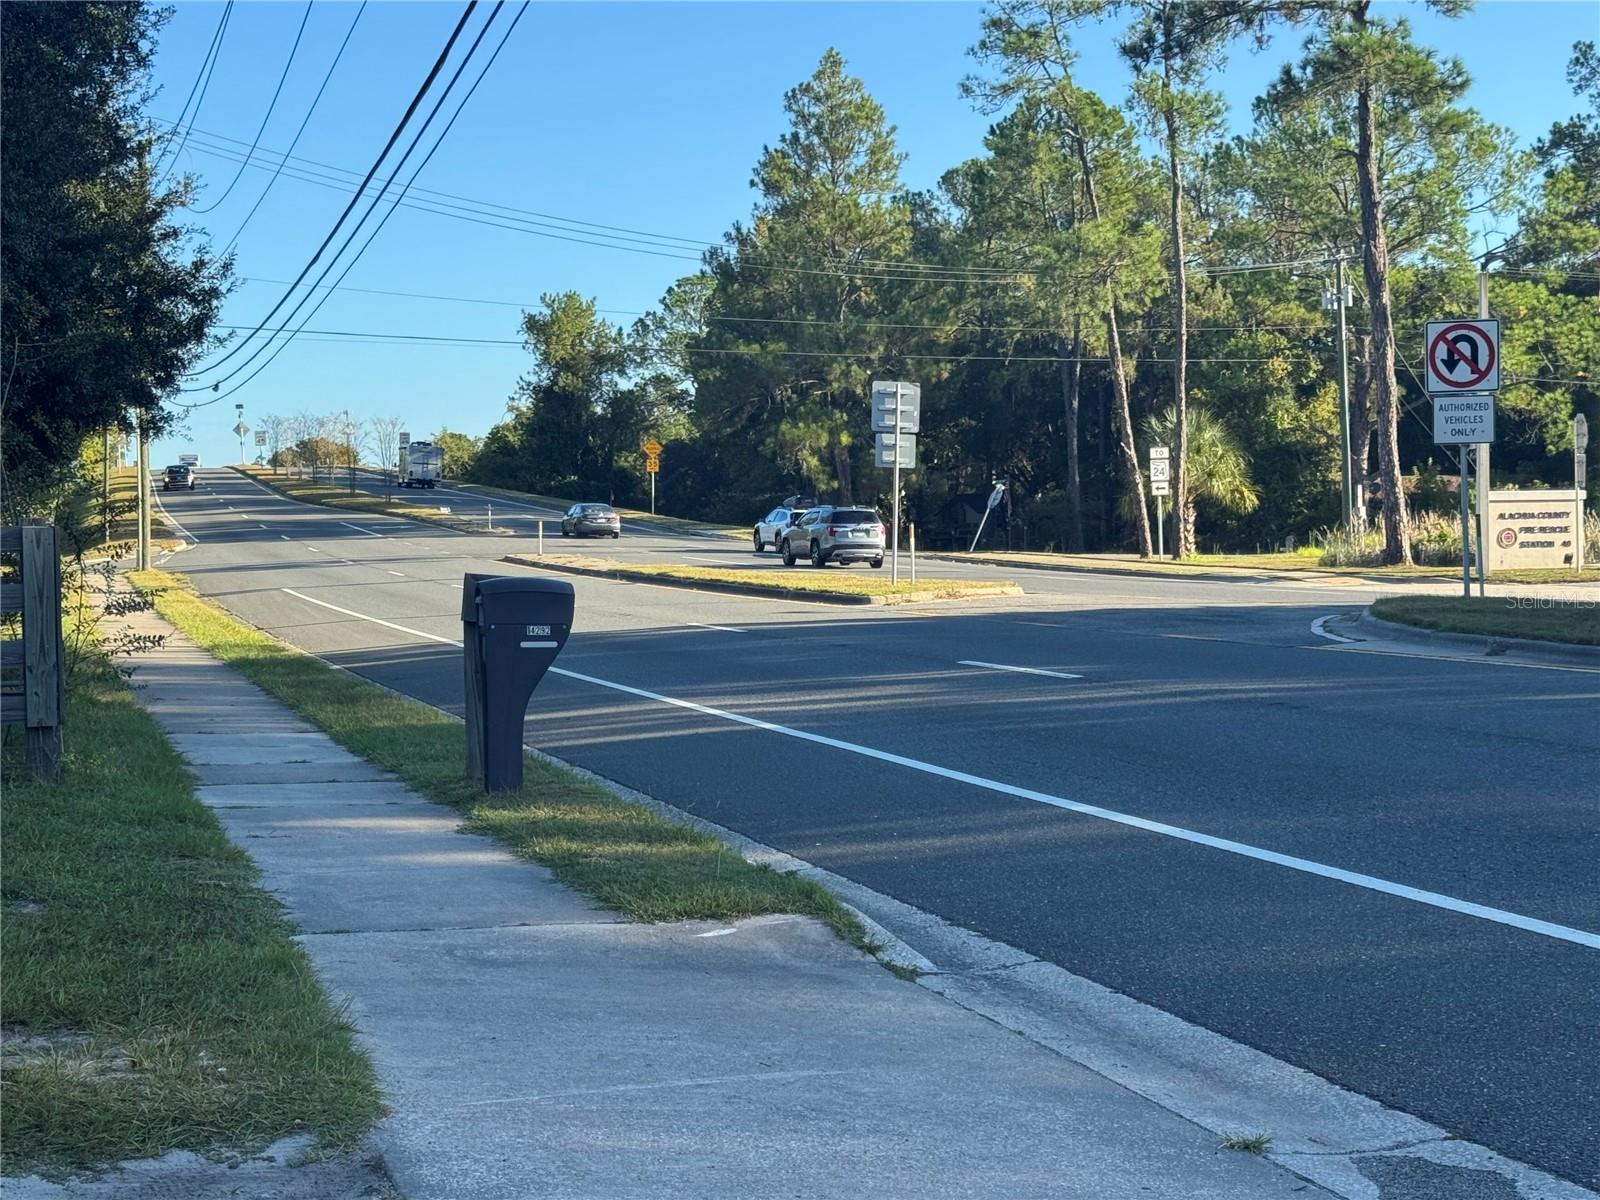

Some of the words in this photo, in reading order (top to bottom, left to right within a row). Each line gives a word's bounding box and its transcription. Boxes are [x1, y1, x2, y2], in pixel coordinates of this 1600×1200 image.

[1438, 402, 1490, 412] AUTHORIZED
[1444, 415, 1484, 425] VEHICLES
[1450, 428, 1477, 437] ONLY
[1153, 467, 1165, 477] 24
[1497, 512, 1536, 520] ALACHUA
[1537, 511, 1571, 519] COUNTY
[1538, 525, 1572, 534] RESCUE
[1518, 540, 1555, 549] STATION
